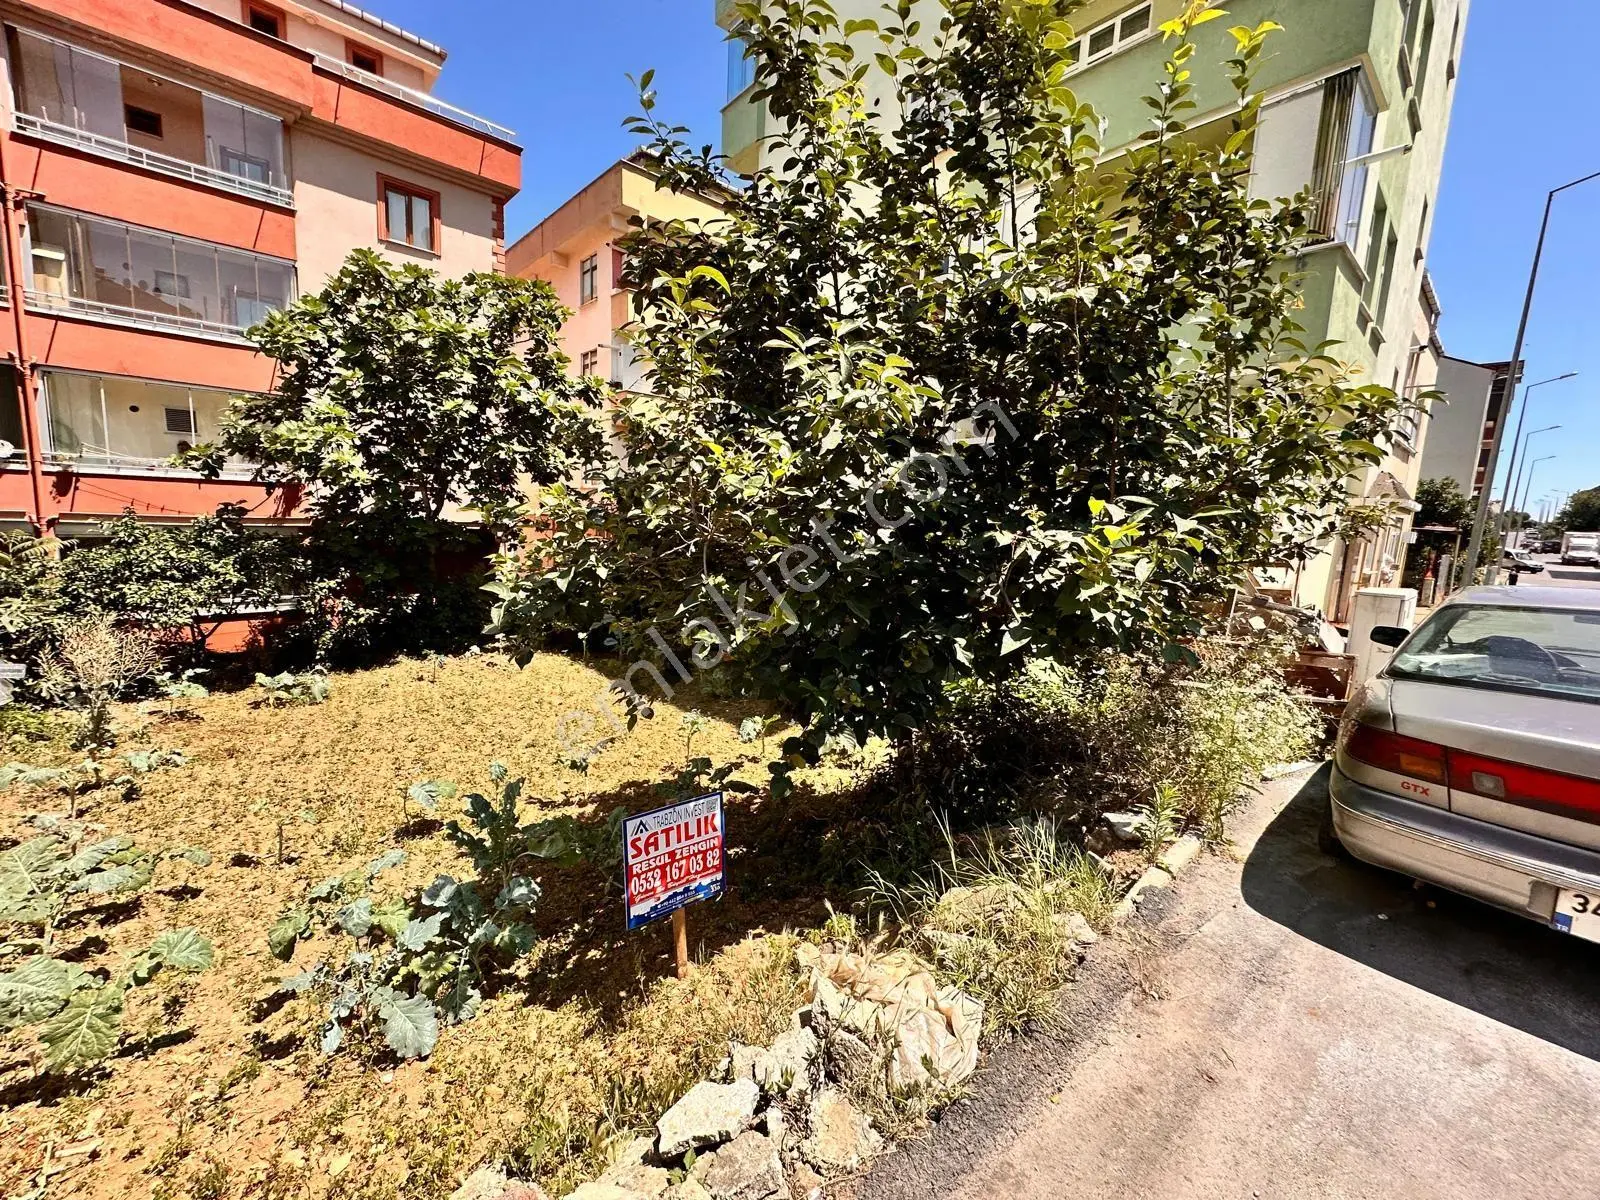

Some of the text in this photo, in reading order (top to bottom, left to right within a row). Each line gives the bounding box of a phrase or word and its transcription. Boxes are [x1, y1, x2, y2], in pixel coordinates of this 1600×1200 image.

[1400, 781, 1430, 797] GTX
[684, 802, 706, 820] INVEST
[630, 813, 719, 860] SATILIK
[631, 868, 662, 896] 0532
[665, 860, 687, 883] 167
[689, 855, 704, 874] 03
[706, 848, 721, 868] 82
[632, 853, 672, 875] RESUL
